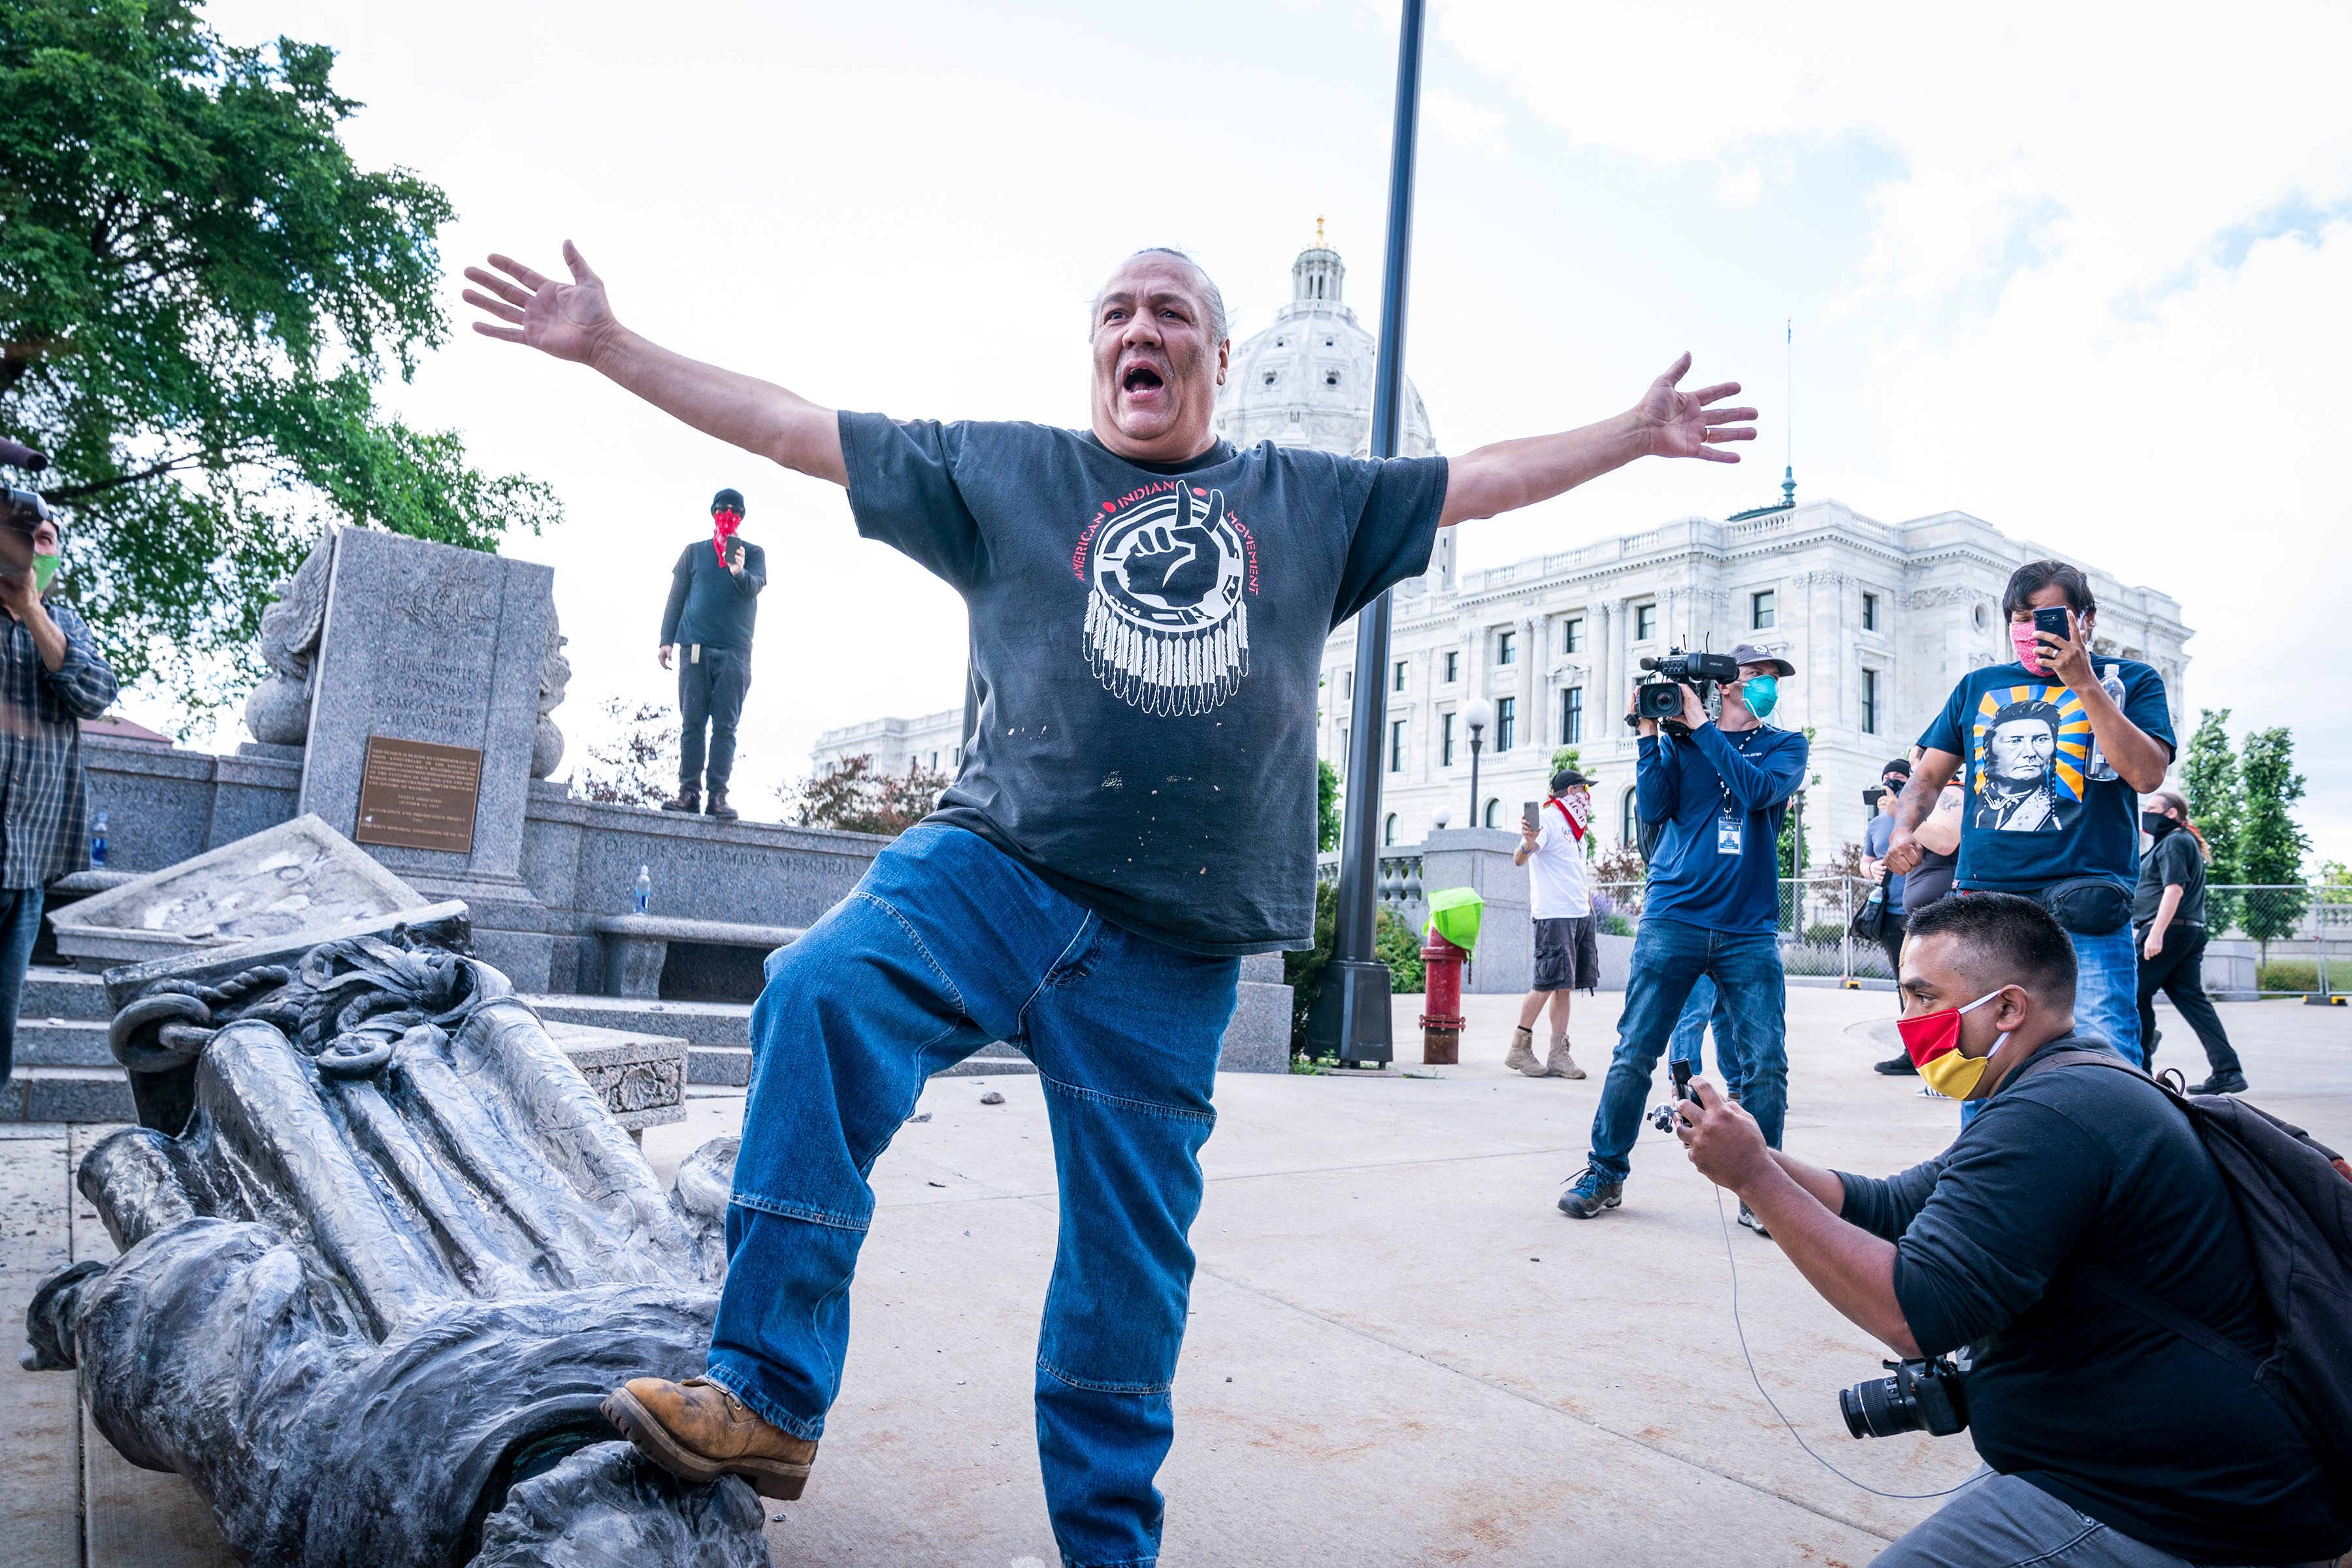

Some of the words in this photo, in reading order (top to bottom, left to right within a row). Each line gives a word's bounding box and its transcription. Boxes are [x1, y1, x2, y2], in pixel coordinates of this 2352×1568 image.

[1072, 512, 1105, 581] AMERICAN
[1117, 480, 1175, 509] INDIAN
[1226, 509, 1260, 595] MOVEMENT
[639, 842, 669, 858] THE
